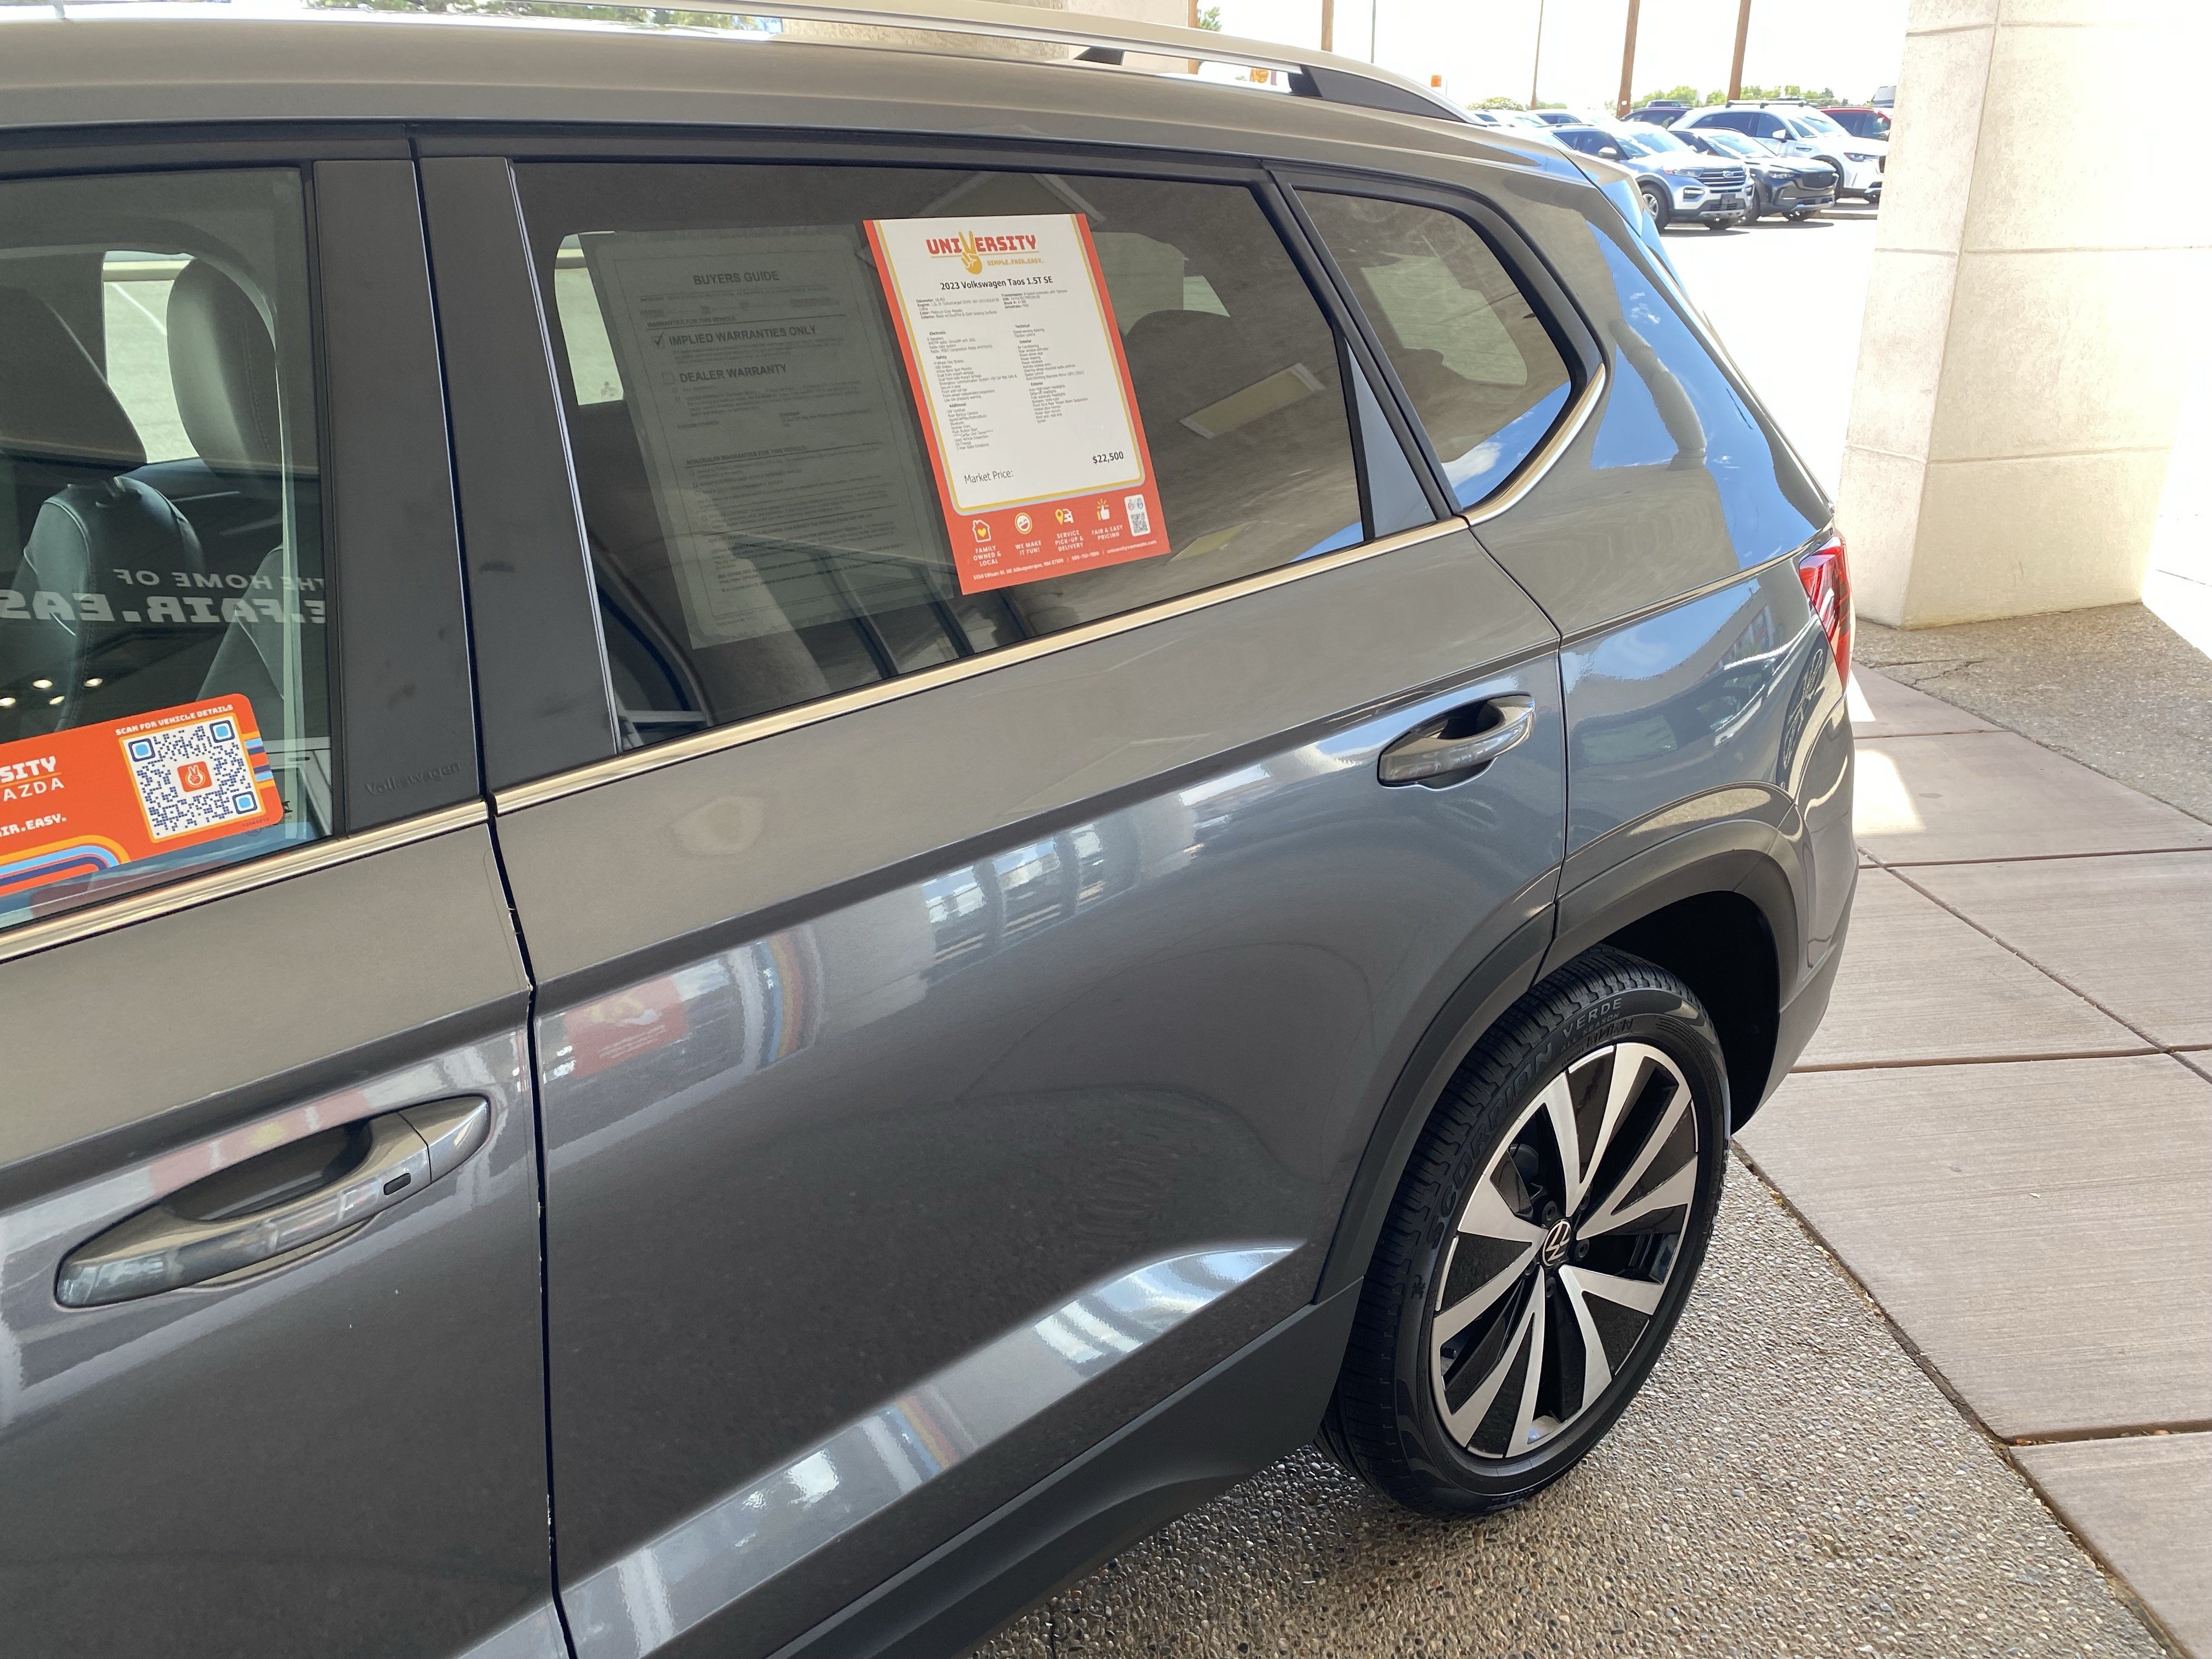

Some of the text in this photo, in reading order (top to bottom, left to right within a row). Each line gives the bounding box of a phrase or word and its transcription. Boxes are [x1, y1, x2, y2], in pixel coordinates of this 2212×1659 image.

[693, 270, 778, 284] BUYERS GUIDE
[668, 332, 713, 345] IMPLIED
[715, 328, 787, 341] WARRANTIES
[789, 325, 817, 336] ONLY
[679, 364, 788, 382] DEALER WARRANTY
[1093, 452, 1124, 464] $22,500
[964, 470, 1013, 483] Market Price:
[1055, 537, 1077, 545] PICK-UP
[1057, 530, 1079, 539] SERVICE
[1058, 543, 1082, 551] DELIVERY
[973, 552, 995, 561] OWNED
[116, 704, 234, 736] SCAN FOR VEHICLE DETAILS
[3, 777, 65, 802] AZDA
[1562, 997, 1622, 1039] VERDE
[1426, 1041, 1553, 1250] SCORPION
